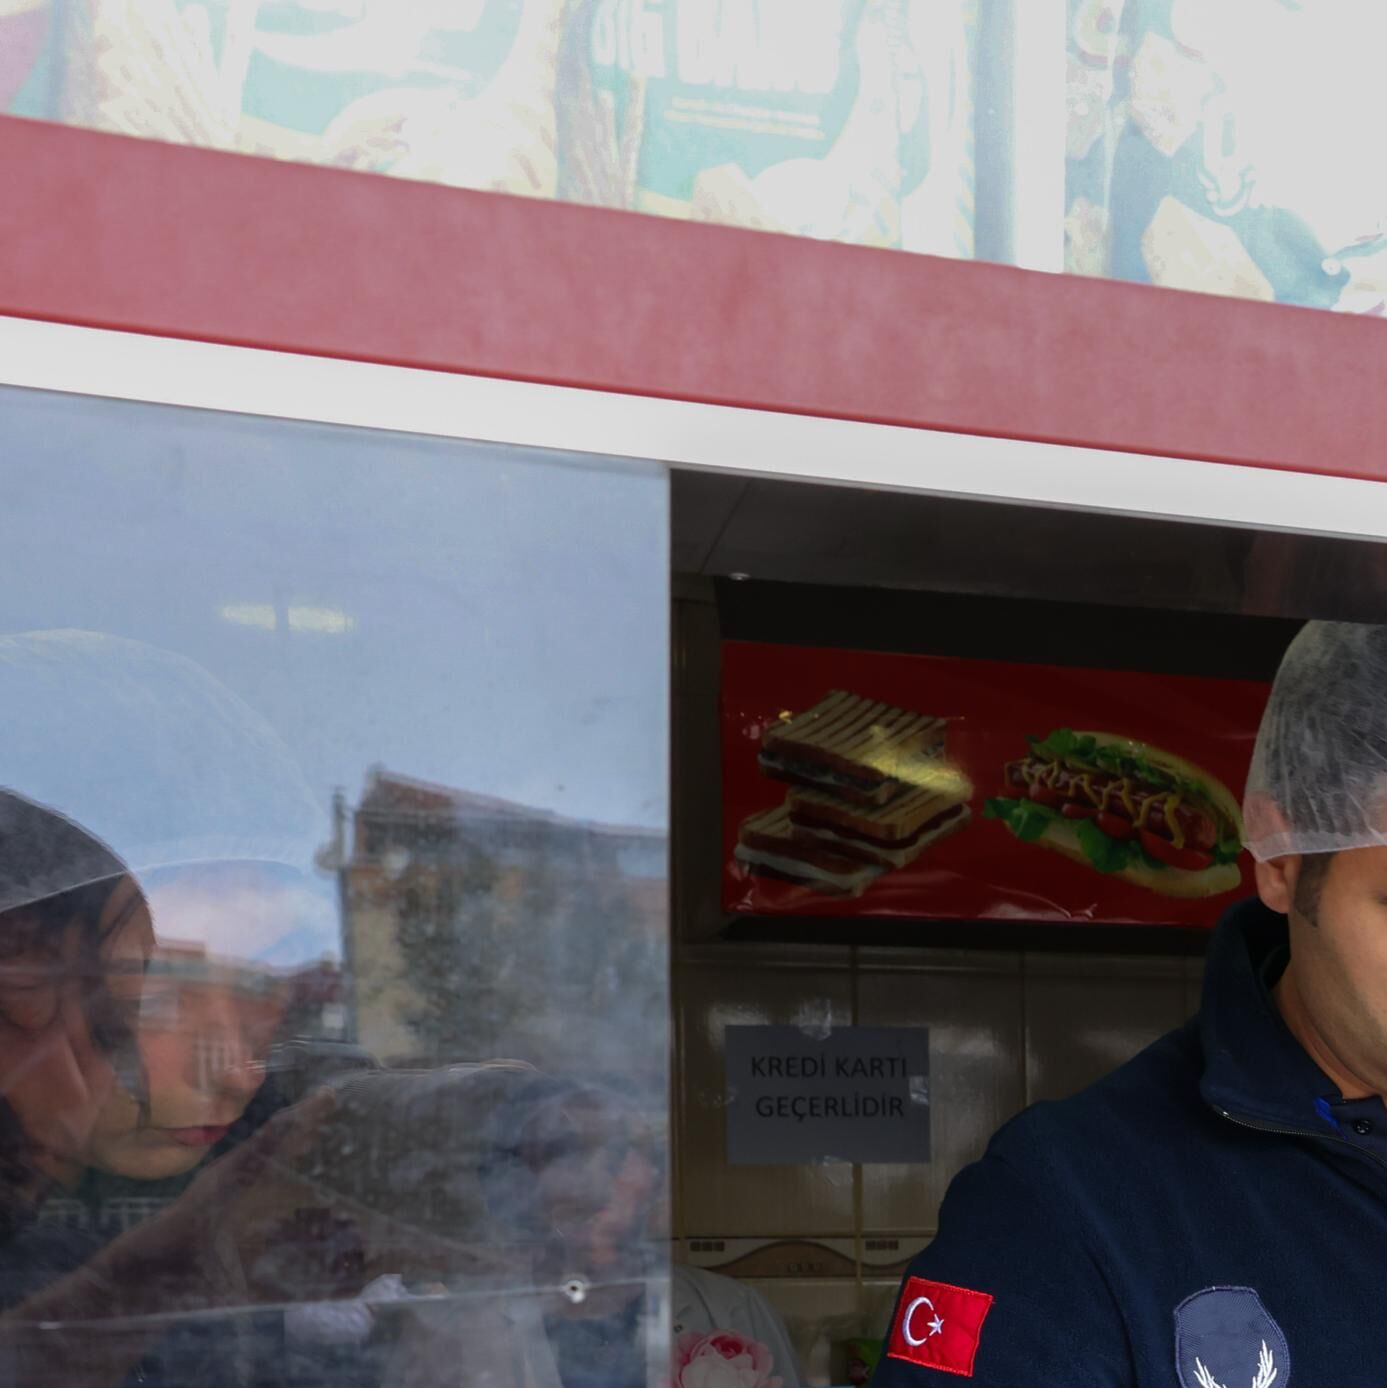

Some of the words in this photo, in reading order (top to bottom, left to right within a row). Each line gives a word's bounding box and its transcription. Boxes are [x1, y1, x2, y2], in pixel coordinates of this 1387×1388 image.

[751, 1052, 826, 1079] KREDİ
[834, 1056, 908, 1080] KARTI
[755, 1090, 905, 1124] GEÇERLİDİR
